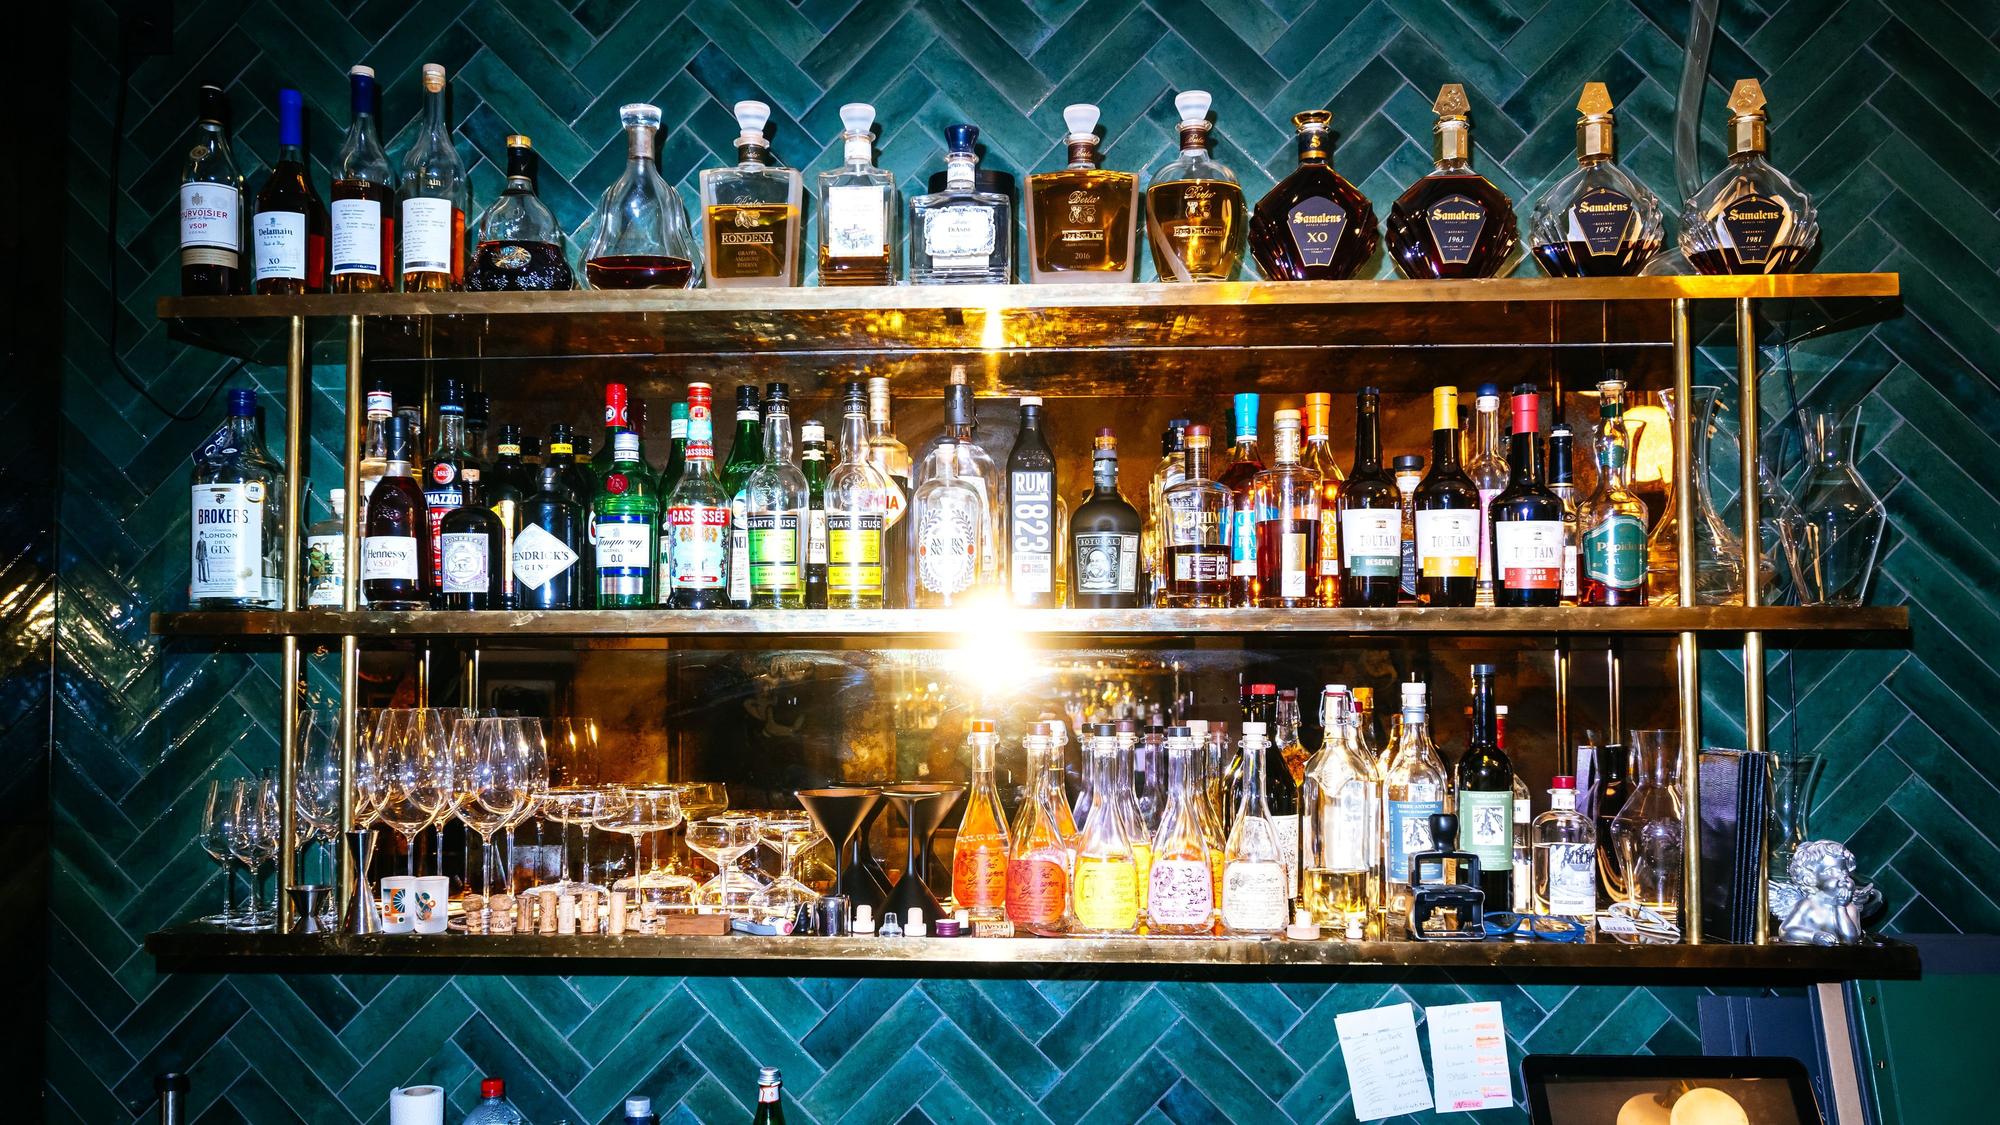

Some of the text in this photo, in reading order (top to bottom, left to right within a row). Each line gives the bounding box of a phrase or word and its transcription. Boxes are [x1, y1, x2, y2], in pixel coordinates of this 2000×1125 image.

[1068, 190, 1098, 205] Berta
[1184, 185, 1214, 200] Berta
[1578, 201, 1628, 214] Samalens
[1293, 211, 1342, 224] Samalens
[1431, 209, 1480, 221] Samalens
[1727, 208, 1779, 221] Samalens
[258, 228, 293, 237] Delamain
[1595, 226, 1613, 234] 1975
[721, 233, 774, 243] RONDENA
[1307, 231, 1328, 243] XO
[1448, 235, 1465, 243] 1963
[1074, 252, 1091, 260] 2016
[1015, 472, 1049, 493] RUM
[425, 493, 462, 505] MAZZOT
[672, 509, 725, 523] CASSSSÉE
[747, 519, 796, 529] HARTRUSE
[828, 519, 881, 529] CHARREUSE
[1014, 493, 1049, 552] 1823
[210, 545, 231, 554] GIN
[367, 549, 408, 560] Hennessy
[610, 553, 623, 563] 0.0
